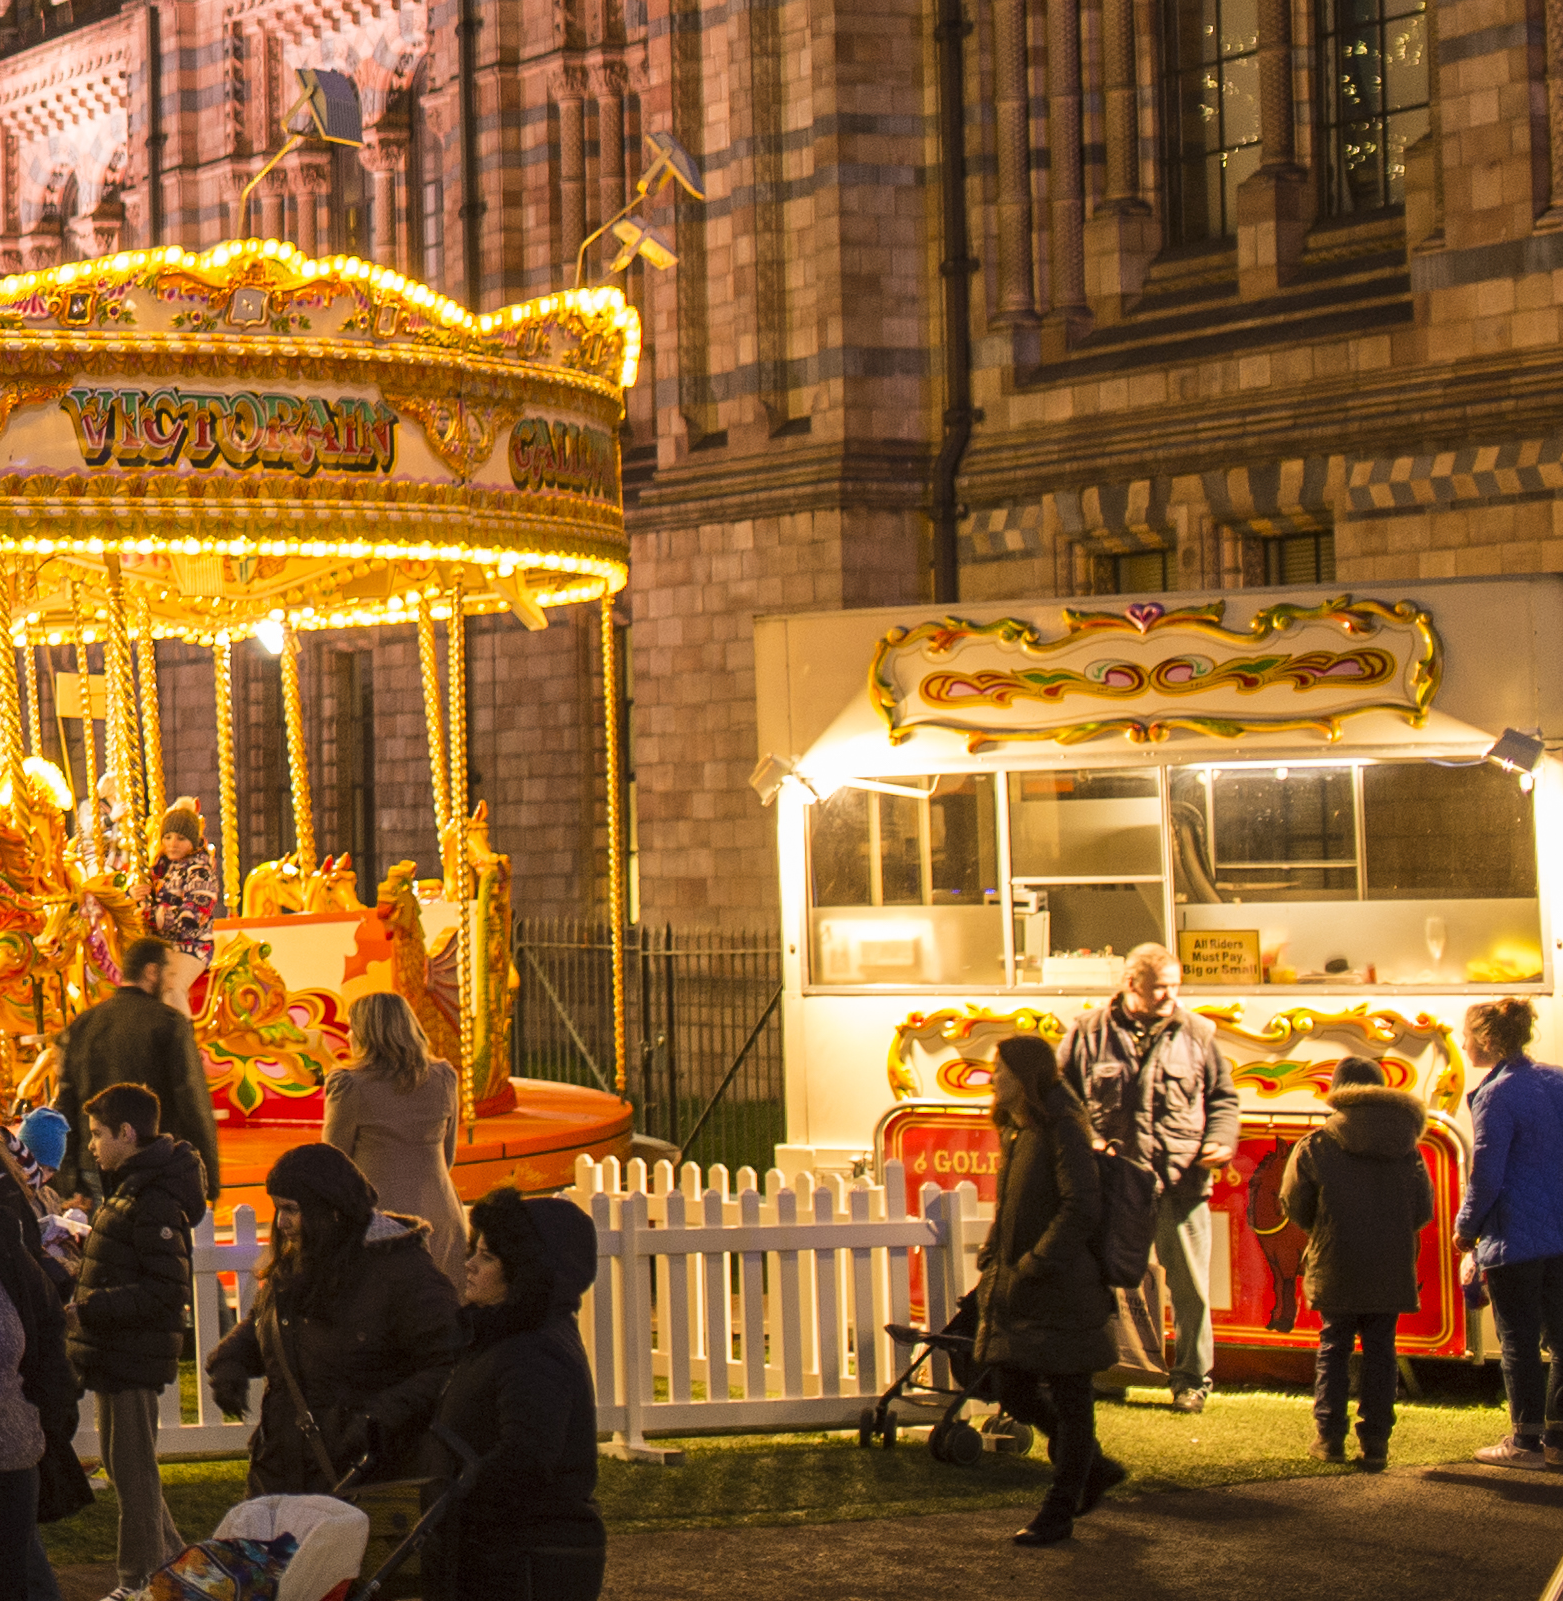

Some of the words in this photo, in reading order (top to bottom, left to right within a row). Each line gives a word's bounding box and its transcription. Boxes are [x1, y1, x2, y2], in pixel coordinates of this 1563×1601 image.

[61, 386, 399, 477] VICTORAIN
[1193, 938, 1208, 949] All
[1209, 938, 1244, 950] Riders
[1191, 951, 1220, 962] Must
[1222, 951, 1247, 964] Pay.
[1182, 964, 1203, 977] Big
[1205, 966, 1219, 975] or
[1221, 964, 1258, 975] Small
